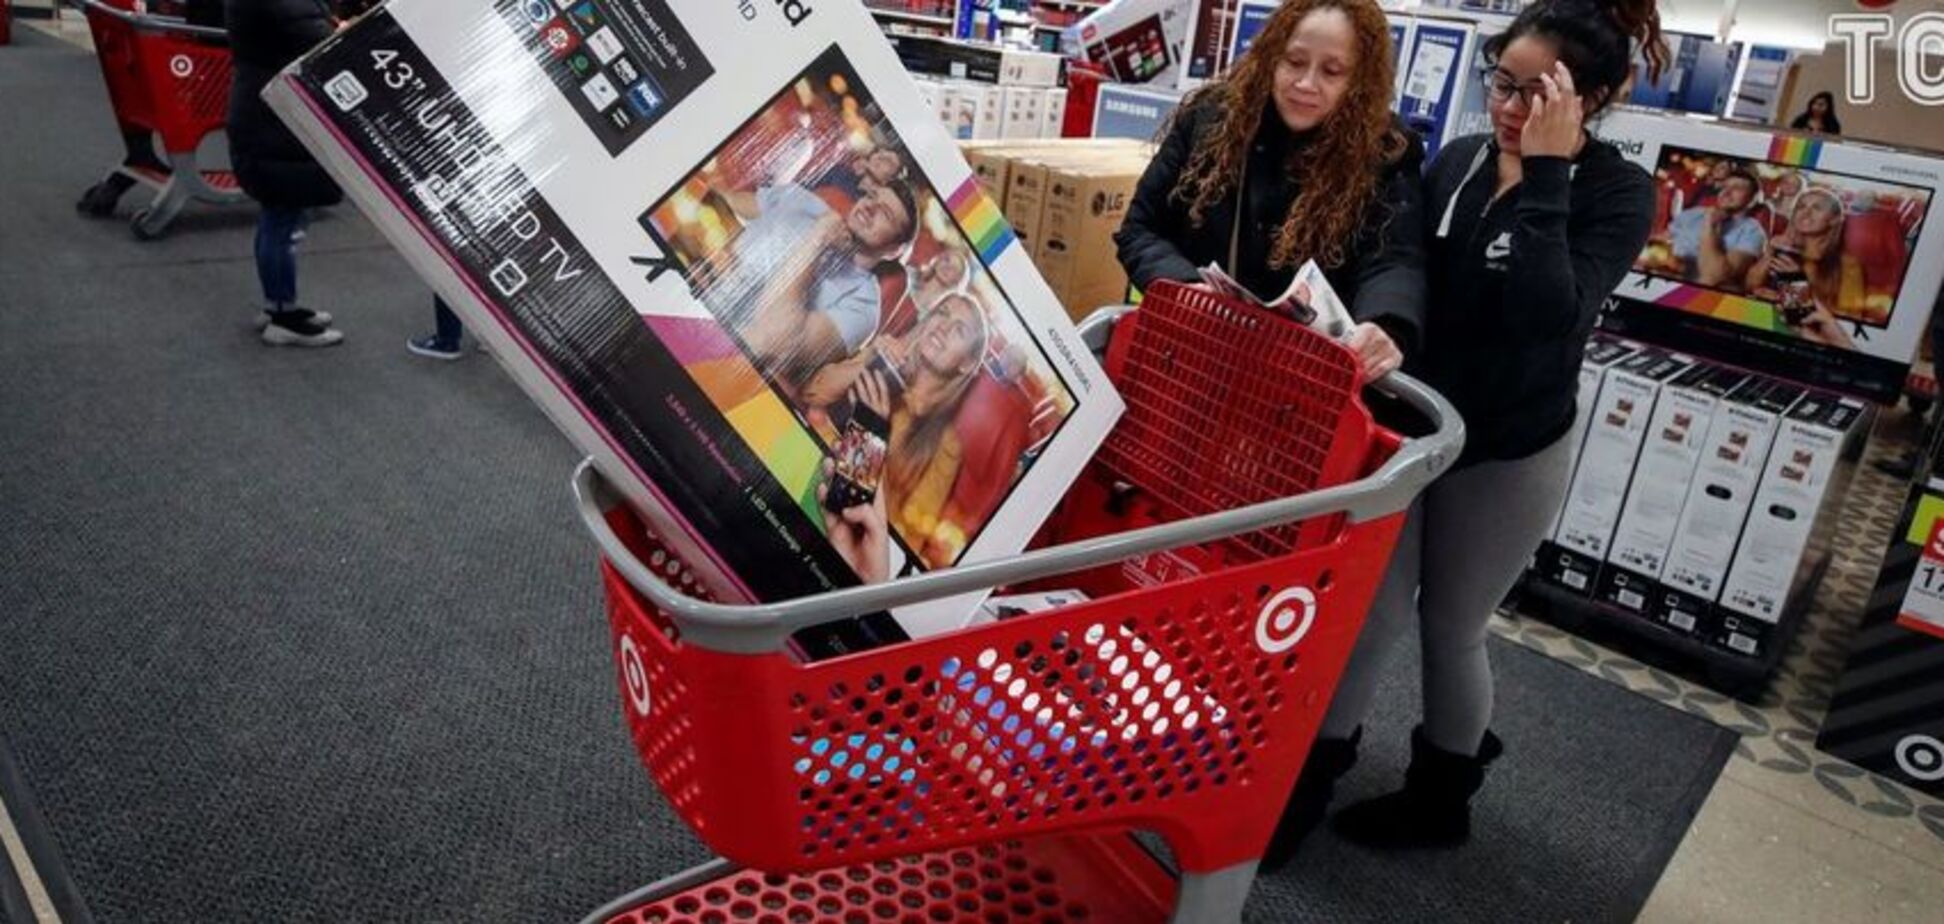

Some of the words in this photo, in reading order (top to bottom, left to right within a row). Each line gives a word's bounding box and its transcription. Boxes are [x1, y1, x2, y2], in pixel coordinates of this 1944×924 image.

[775, 0, 812, 26] d
[1105, 98, 1158, 119] SAMSUNG
[1608, 138, 1645, 155] roid
[1106, 192, 1124, 210] LG
[539, 236, 583, 282] TV
